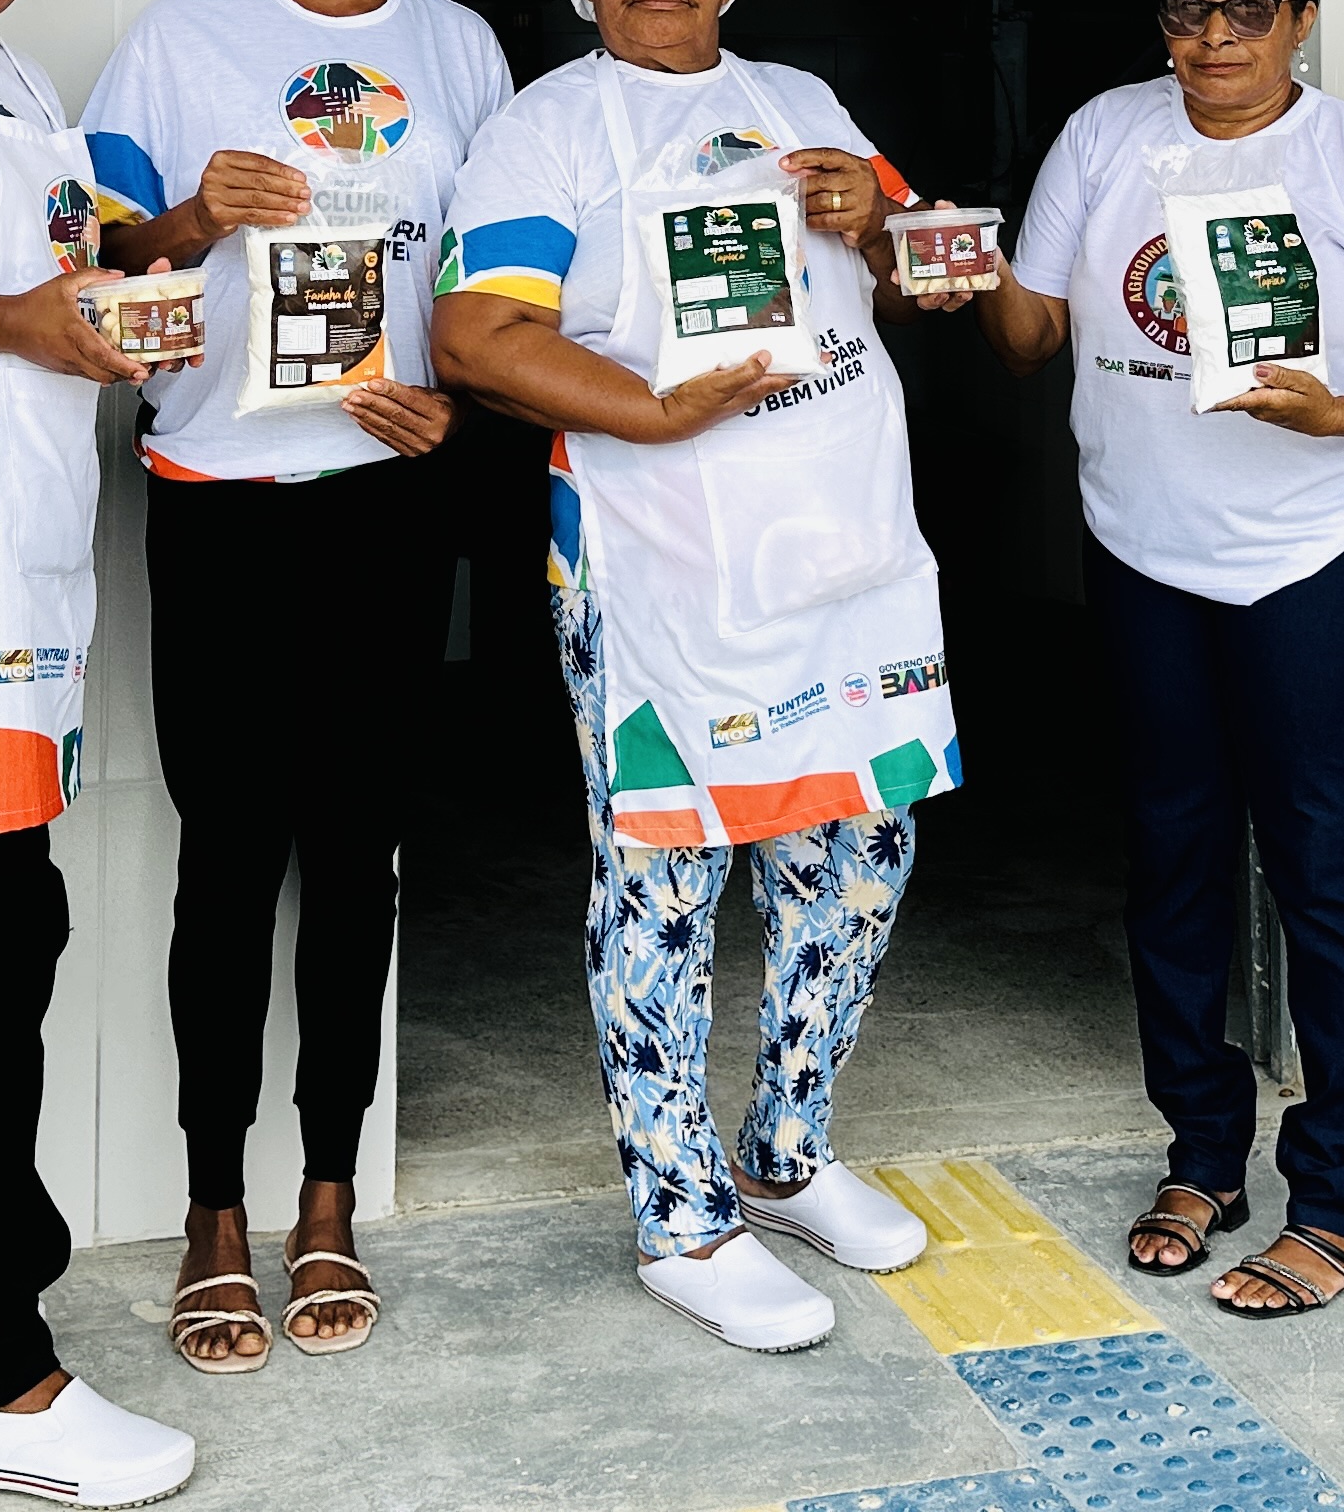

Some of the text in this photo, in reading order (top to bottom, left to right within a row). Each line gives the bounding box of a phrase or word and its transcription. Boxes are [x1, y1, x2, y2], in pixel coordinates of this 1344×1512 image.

[1144, 320, 1168, 346] DA
[764, 359, 865, 412] BEM VIVER
[878, 657, 923, 674] GOVERNO
[767, 682, 825, 718] FUNTRAD
[712, 726, 758, 746] MOC
